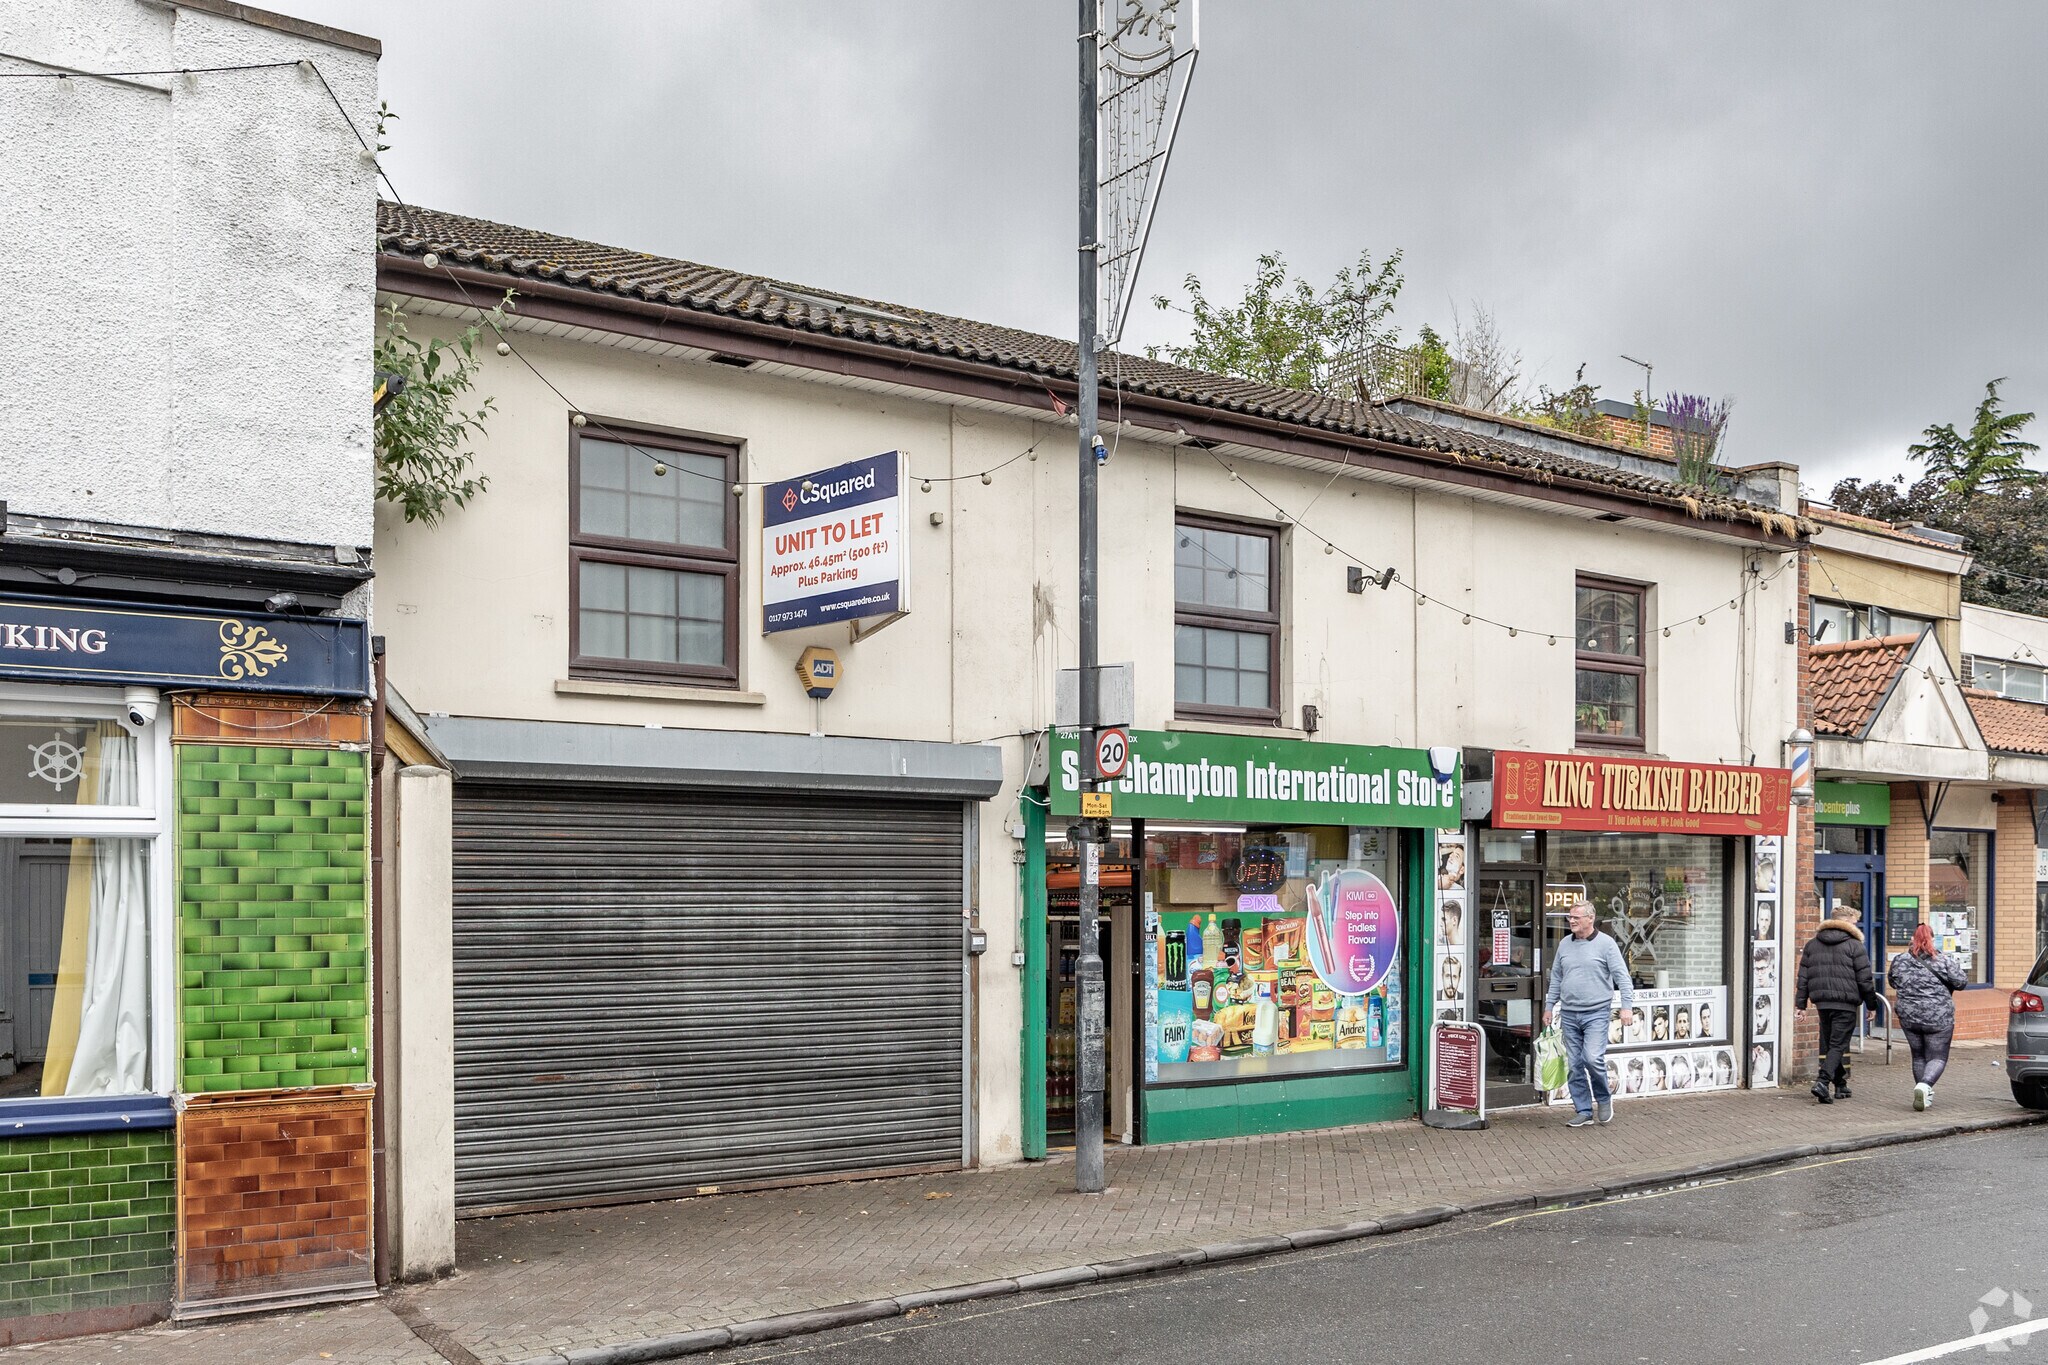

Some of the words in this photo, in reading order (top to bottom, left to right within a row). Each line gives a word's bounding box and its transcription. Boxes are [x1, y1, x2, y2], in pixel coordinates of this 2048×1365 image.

[800, 467, 875, 504] CSquared
[775, 527, 817, 556] UNIT
[821, 522, 846, 546] TO
[850, 512, 884, 540] LET
[770, 560, 807, 578] Approx.
[808, 550, 847, 570] 46.45m²
[848, 547, 870, 561] (500
[872, 540, 888, 555] ft²)
[798, 576, 819, 588] Plus
[820, 567, 858, 584] Parking
[819, 592, 890, 612] www.csquaredre.co.uk
[768, 613, 781, 623] 0117
[782, 611, 794, 621] 973
[794, 609, 808, 619] 1474
[0, 623, 109, 654] KING
[813, 663, 834, 674] ADT
[1101, 742, 1124, 764] 20
[1061, 749, 1238, 803] Sehampton
[1246, 759, 1391, 805] International
[1397, 768, 1454, 808] Store
[1542, 759, 1595, 809] KING
[1601, 763, 1685, 812] TURKISH
[1688, 768, 1763, 815] BARBER
[1814, 799, 1861, 817] obcentreplus
[1607, 814, 1613, 825] If
[1614, 815, 1626, 825] You
[1626, 815, 1641, 826] Look
[1661, 816, 1669, 827] We
[1670, 817, 1684, 827] Look
[1685, 817, 1700, 828] Good
[1235, 863, 1282, 883] OPEN
[1346, 891, 1364, 901] KIWI
[1345, 910, 1363, 921] Step
[1364, 910, 1379, 920] into
[1347, 922, 1377, 932] Endless
[1347, 935, 1377, 944] Flavour
[1638, 991, 1648, 999] FACE
[1662, 990, 1668, 998] NO
[1668, 989, 1693, 998] APPOINTMENT
[1693, 988, 1713, 996] NECESSARY
[1164, 1026, 1187, 1043] FAIRY
[1338, 1024, 1366, 1037] Andrex
